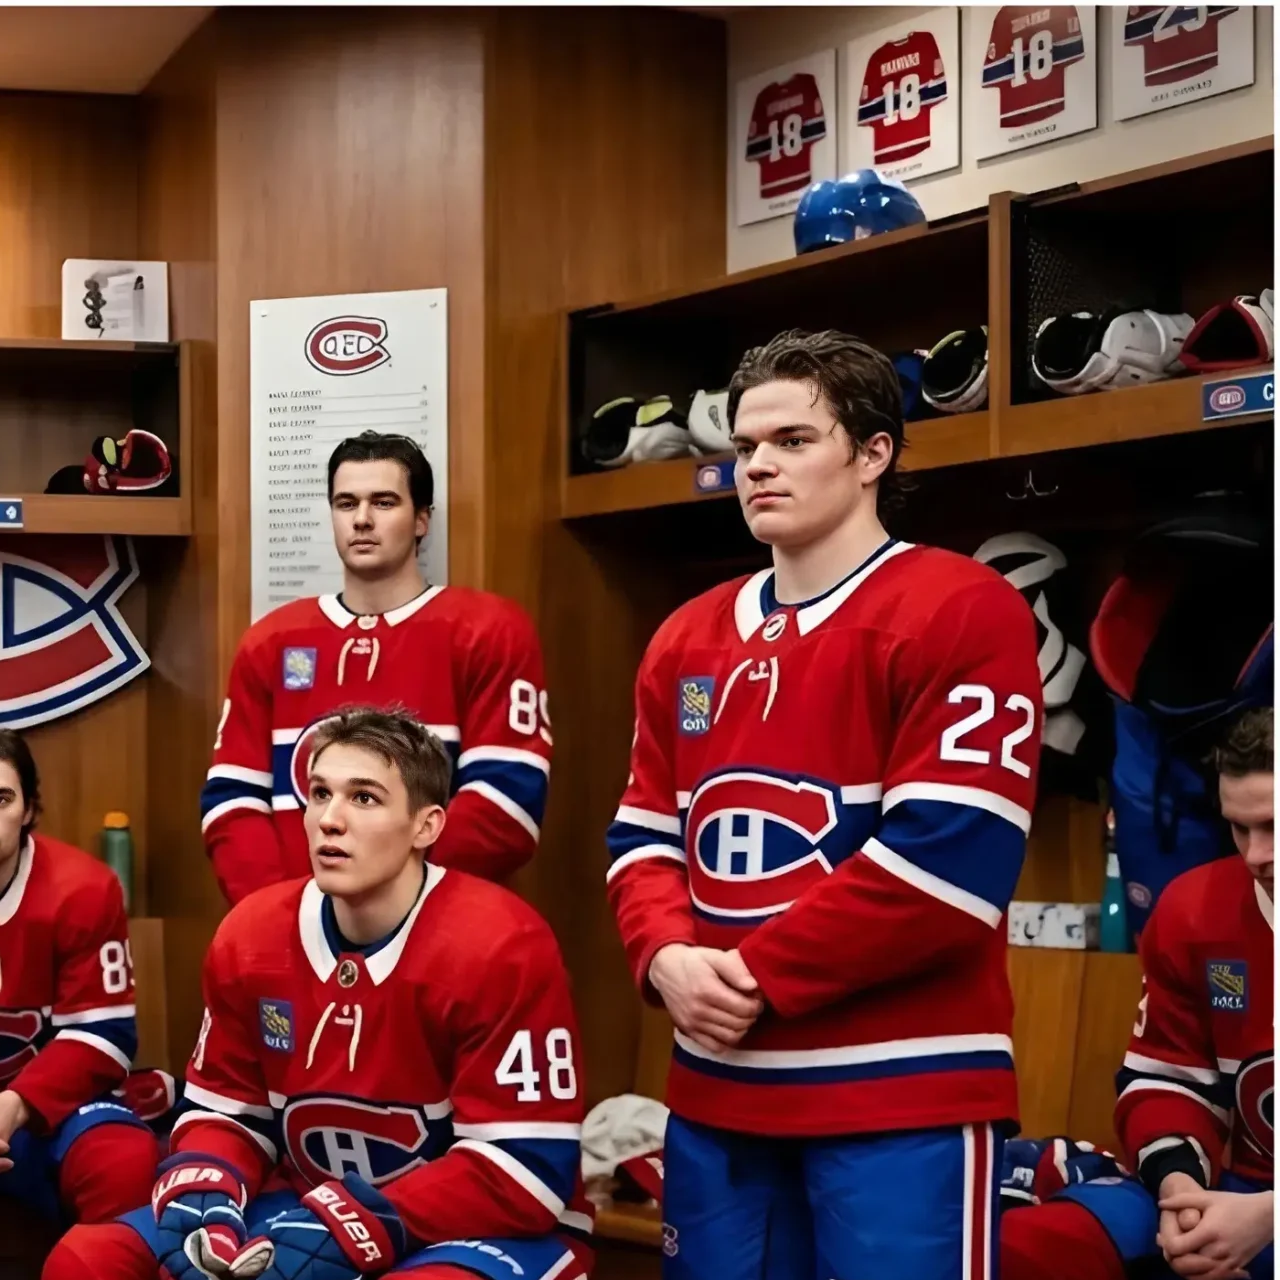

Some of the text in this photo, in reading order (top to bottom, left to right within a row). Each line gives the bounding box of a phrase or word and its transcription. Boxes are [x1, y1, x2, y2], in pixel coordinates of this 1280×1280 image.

[883, 74, 921, 127] 18
[768, 114, 802, 162] 18
[940, 683, 1035, 779] 22
[494, 1027, 577, 1102] 48
